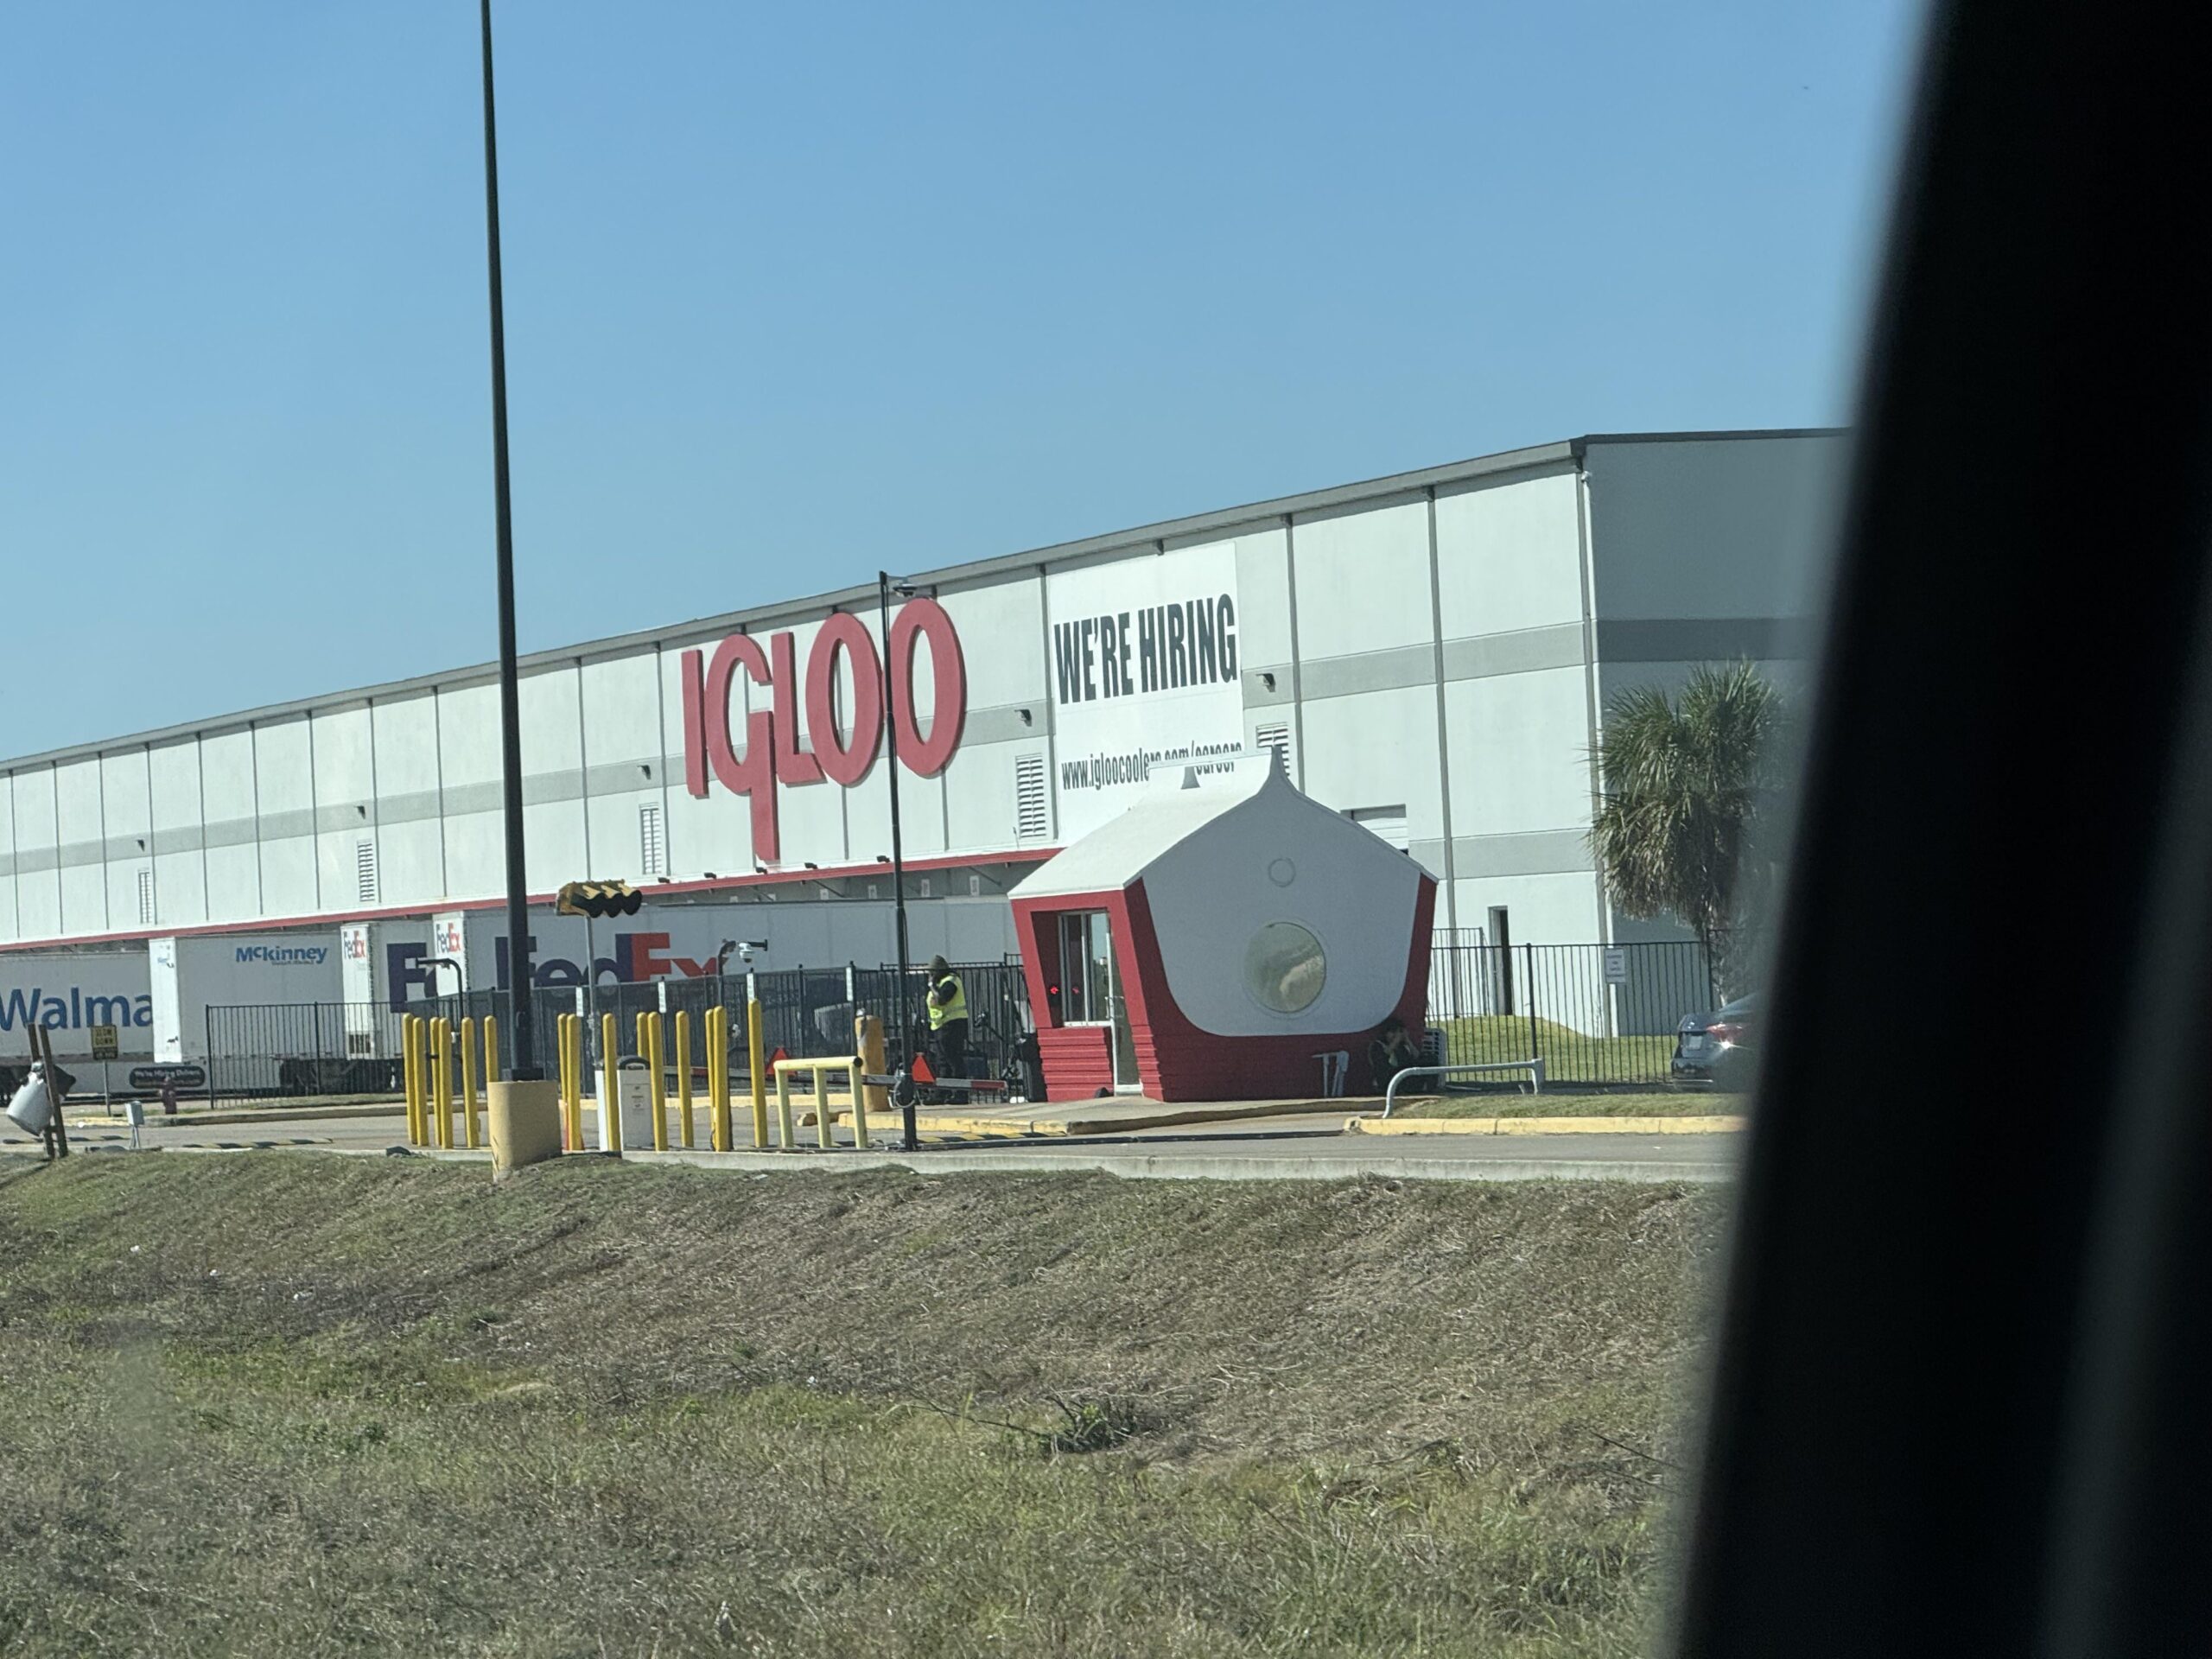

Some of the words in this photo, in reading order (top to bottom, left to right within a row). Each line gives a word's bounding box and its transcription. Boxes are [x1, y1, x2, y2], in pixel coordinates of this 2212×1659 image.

[1054, 611, 1134, 704] WE'RE
[1138, 594, 1237, 693] HIRING
[681, 597, 967, 861] IGLOO
[343, 930, 366, 959] FedEx
[436, 923, 461, 953] FedEx
